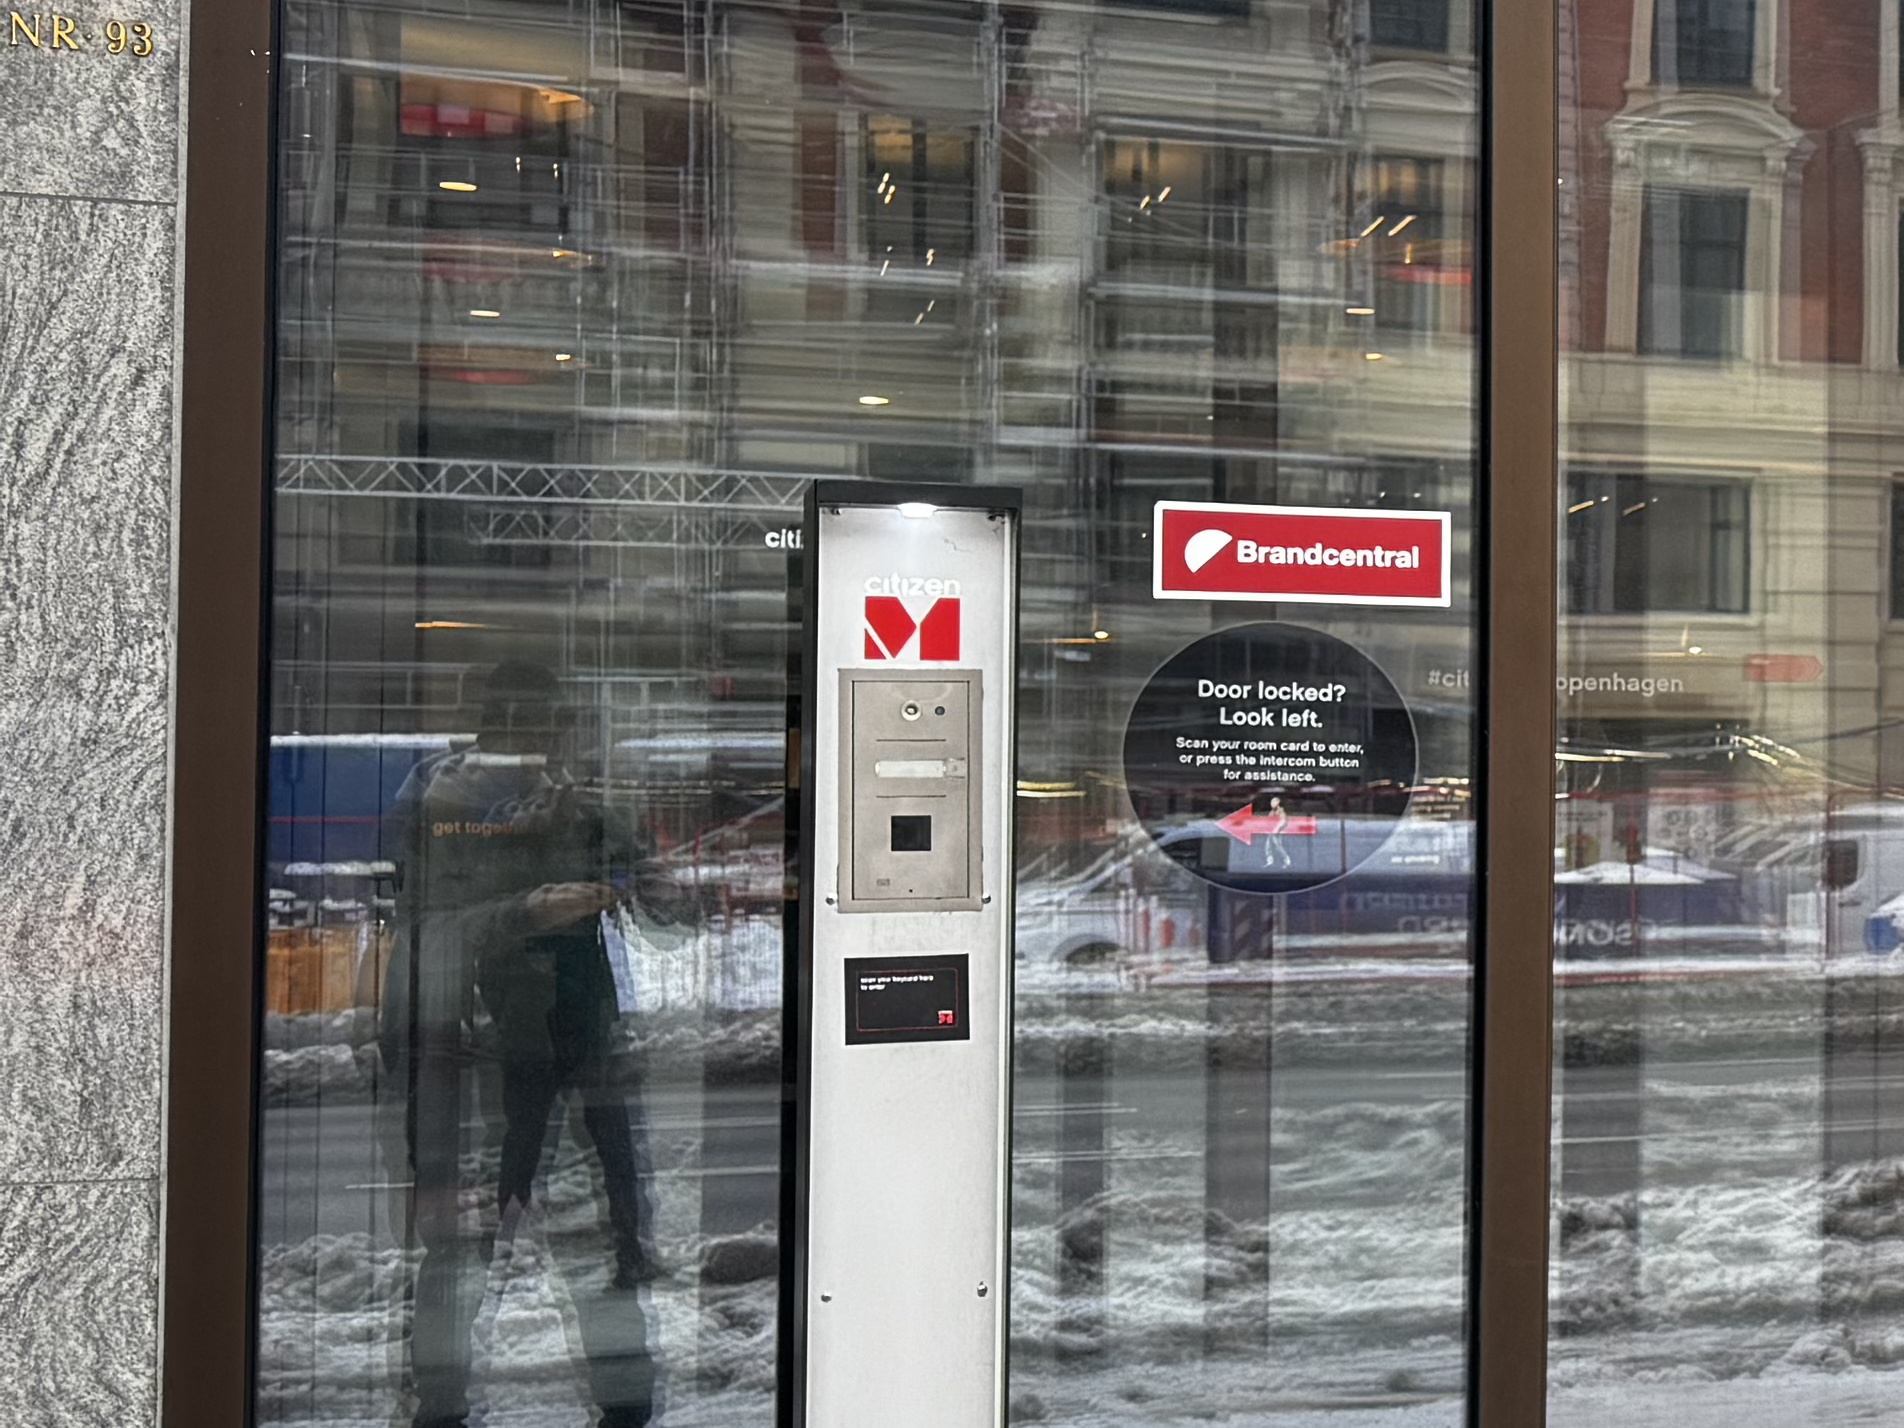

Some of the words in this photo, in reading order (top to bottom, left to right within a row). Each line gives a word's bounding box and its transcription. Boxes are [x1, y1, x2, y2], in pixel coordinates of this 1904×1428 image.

[106, 20, 153, 56] 93
[765, 528, 804, 550] citi
[1237, 539, 1419, 569] Brandcentral
[864, 572, 961, 597] citizen
[1198, 678, 1251, 699] Door
[1258, 679, 1346, 703] locked?
[1219, 706, 1274, 727] Look
[1281, 708, 1323, 728] left.
[1175, 736, 1208, 749] Scan
[1212, 739, 1241, 752] your
[1243, 741, 1277, 751] room
[1280, 740, 1310, 752] card
[1313, 742, 1326, 753] to
[1329, 743, 1364, 755] enter,
[1178, 754, 1193, 764] or
[1196, 755, 1233, 767] press
[1235, 753, 1256, 765] the
[1259, 754, 1316, 767] intercom
[1319, 755, 1360, 768] button
[1223, 768, 1241, 780] for
[1244, 769, 1316, 782] assistance.
